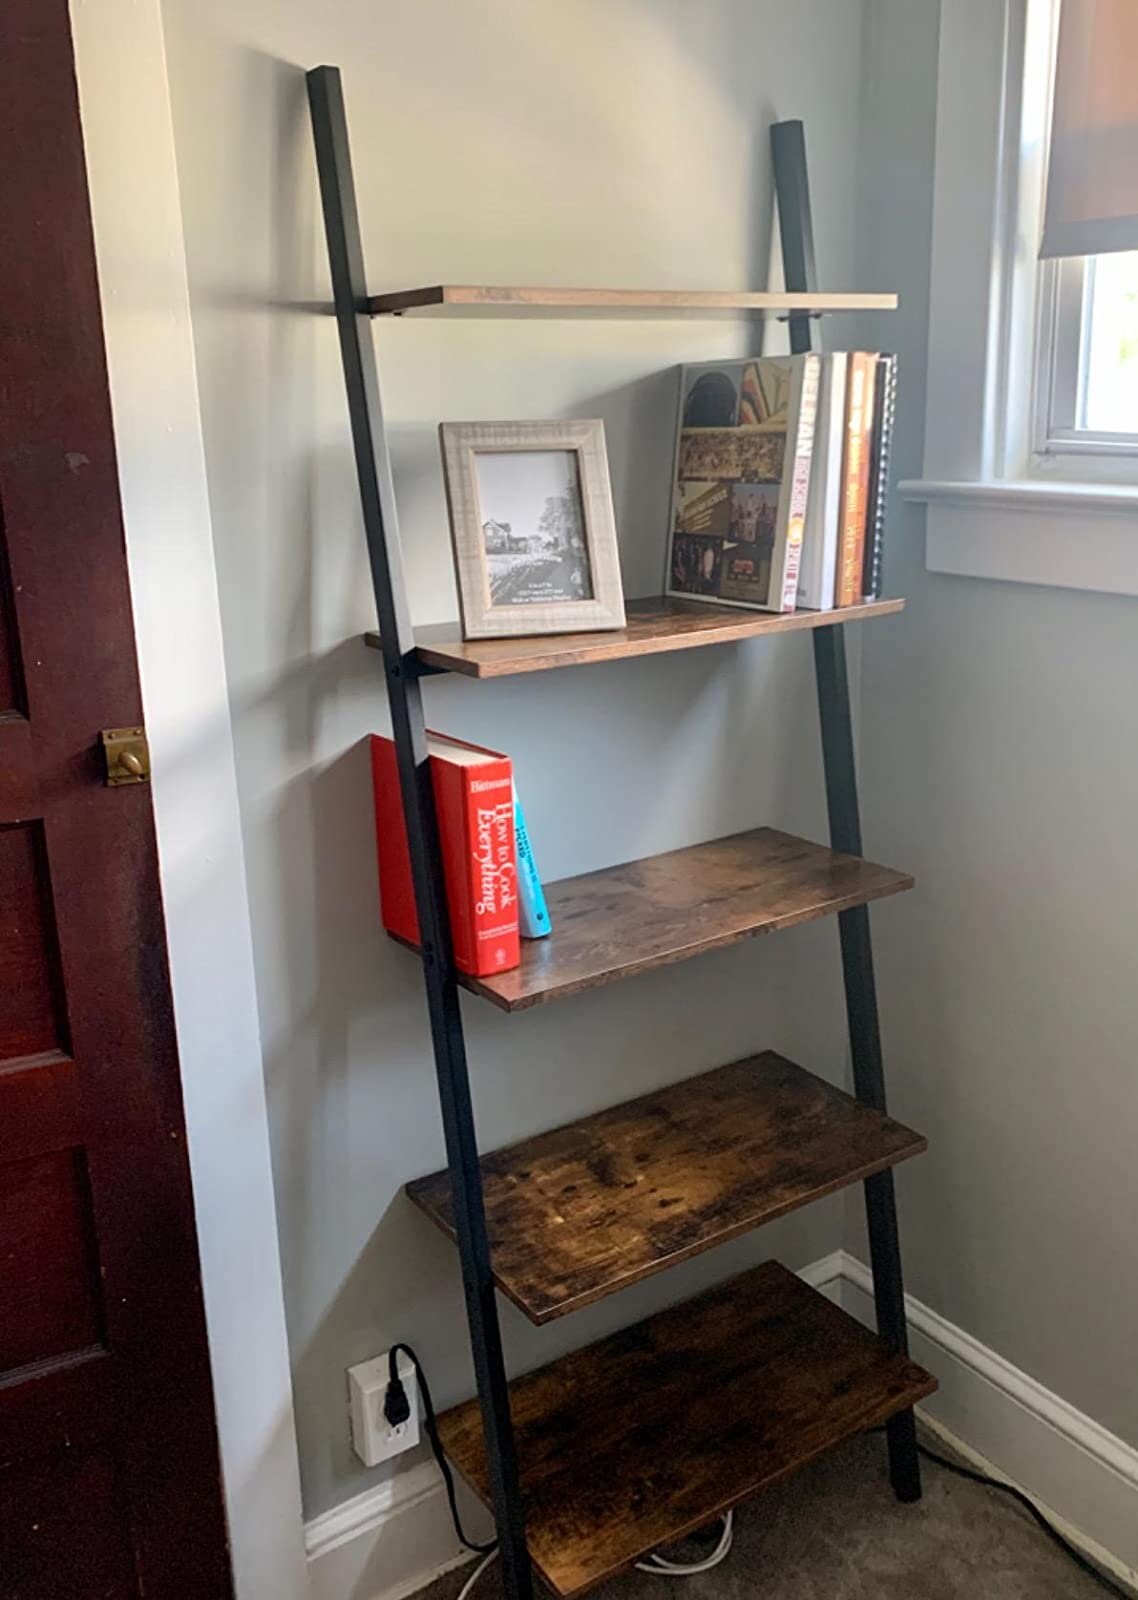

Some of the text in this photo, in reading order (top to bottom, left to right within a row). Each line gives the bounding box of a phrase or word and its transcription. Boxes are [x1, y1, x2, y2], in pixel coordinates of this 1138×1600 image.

[473, 809, 499, 915] Everything
[495, 801, 518, 909] How to Cook
